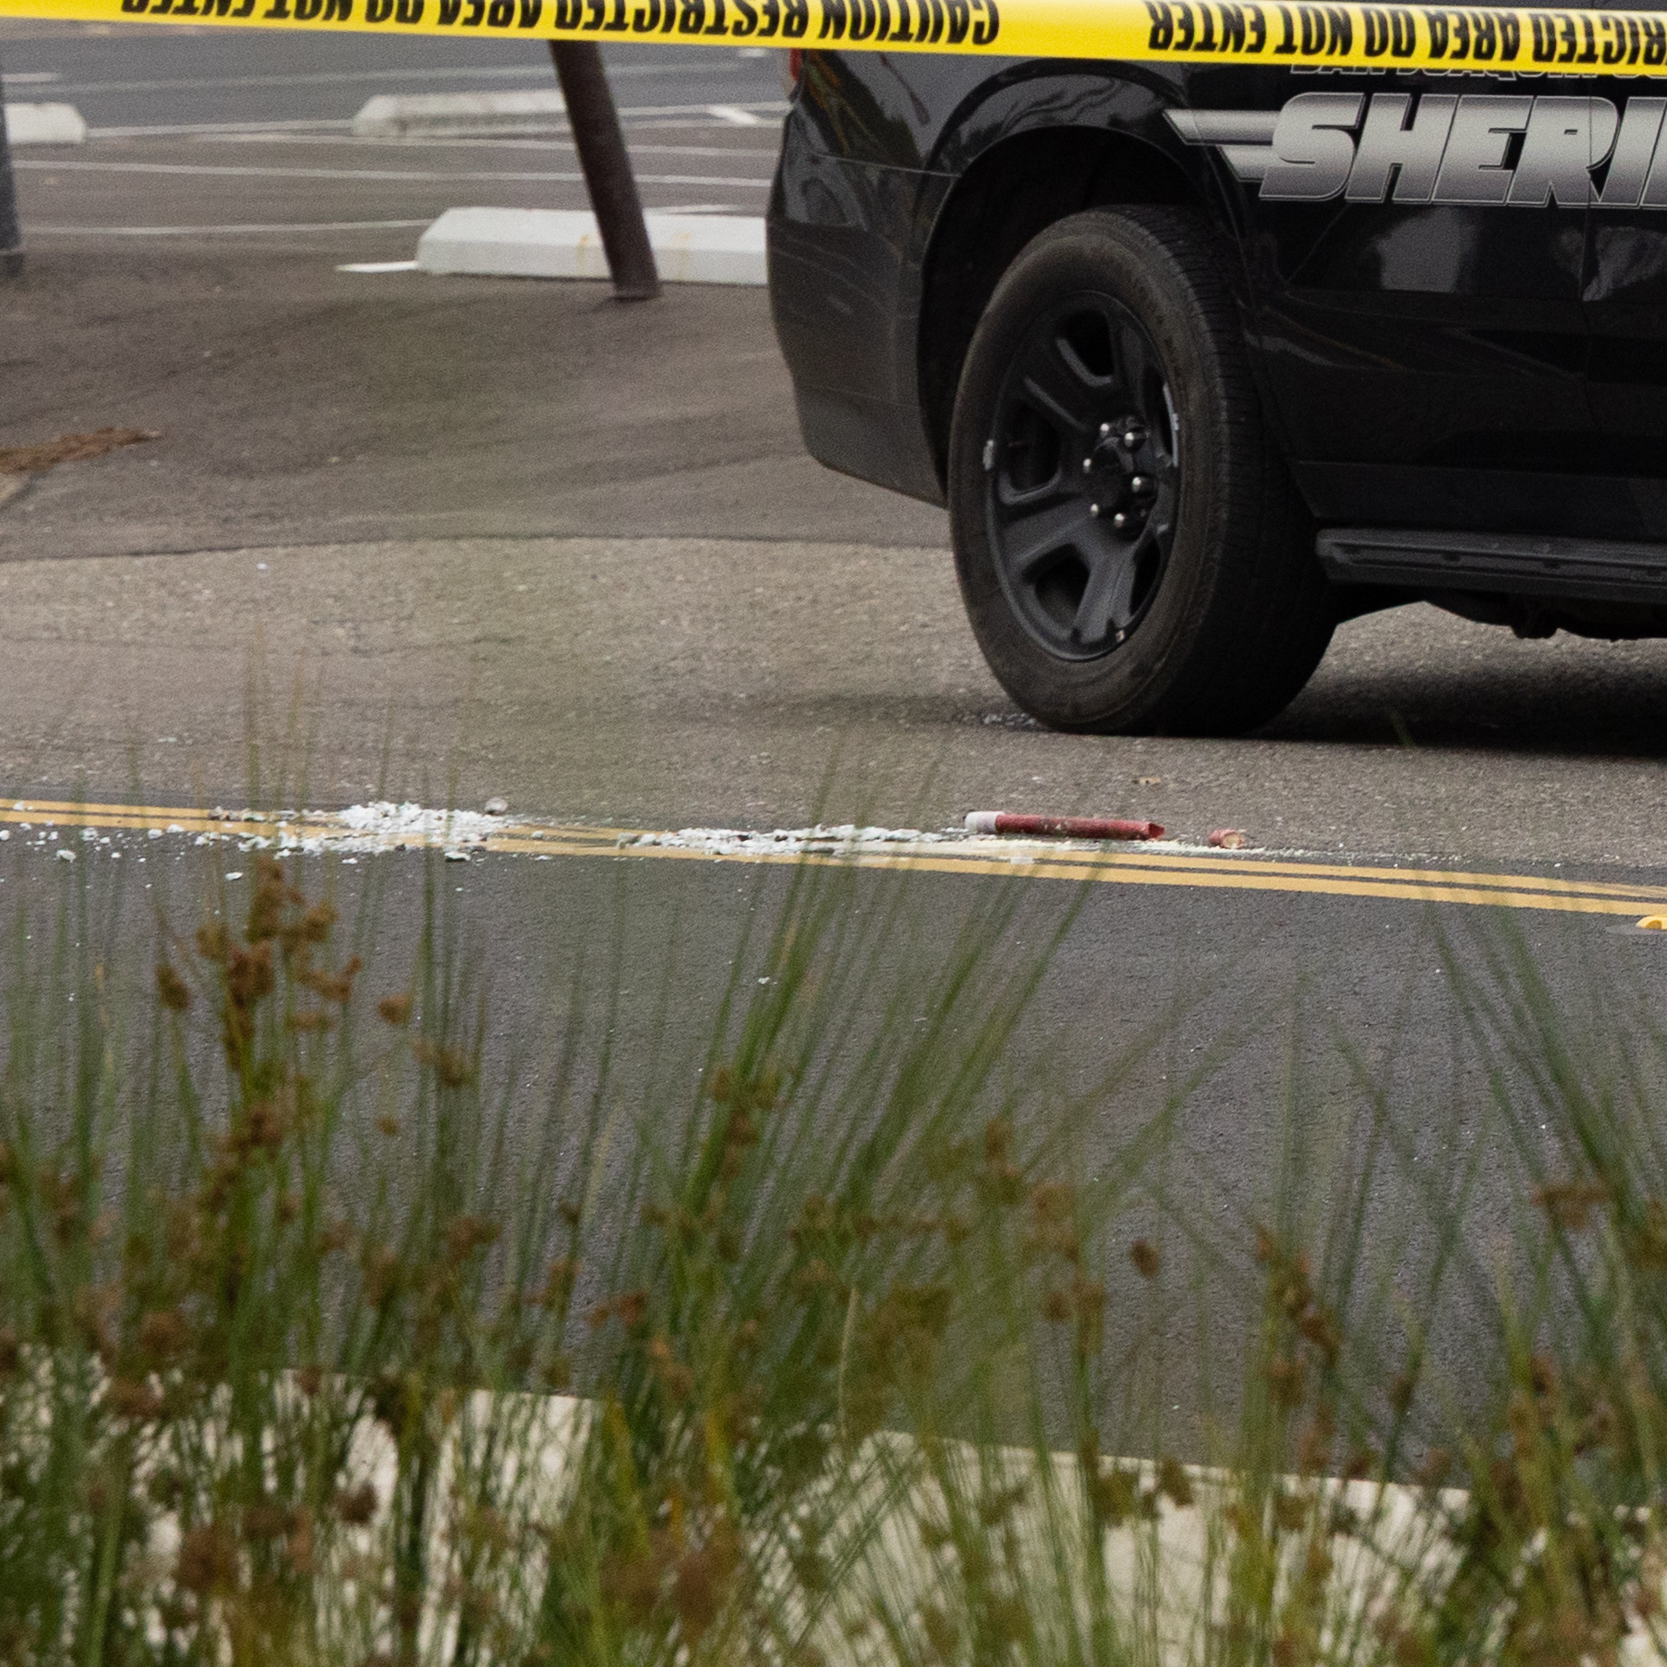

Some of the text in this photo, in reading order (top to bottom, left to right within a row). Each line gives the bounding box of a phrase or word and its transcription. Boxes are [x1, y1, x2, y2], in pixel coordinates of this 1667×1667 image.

[1144, 0, 1266, 54] ENTER
[1272, 3, 1354, 57] NOT
[1359, 5, 1417, 59] DO
[1422, 8, 1521, 62] AREA
